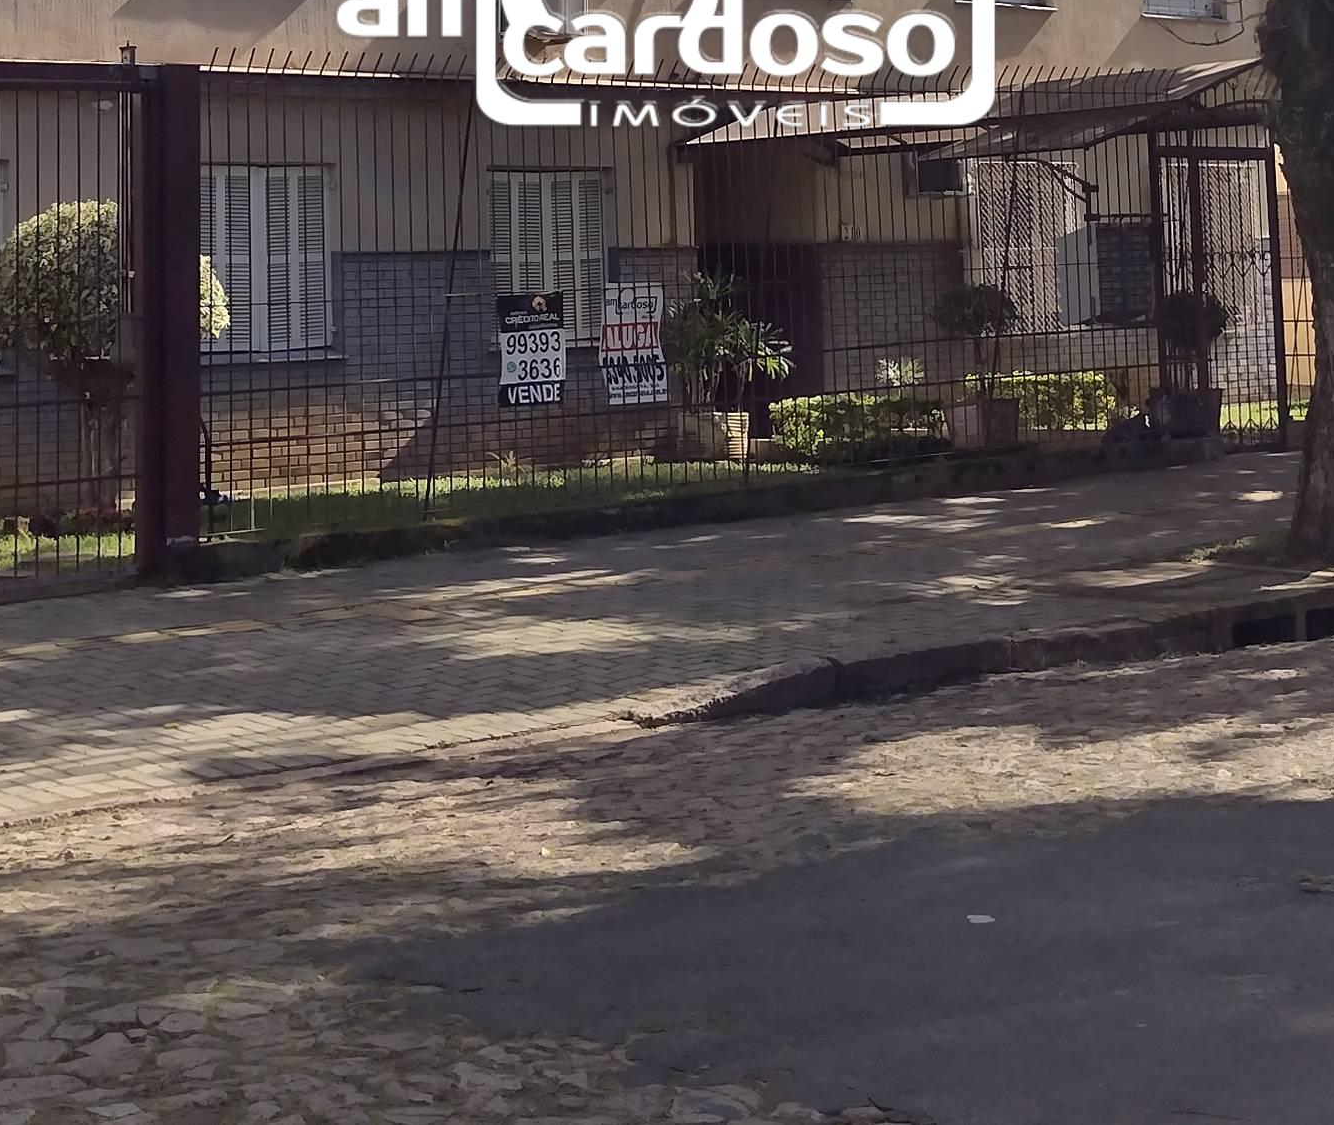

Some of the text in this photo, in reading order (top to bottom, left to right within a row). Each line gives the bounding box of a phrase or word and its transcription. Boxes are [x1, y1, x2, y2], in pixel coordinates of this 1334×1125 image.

[506, 331, 561, 355] 99393
[602, 324, 657, 350] ALUGA
[518, 357, 560, 380] 3636
[508, 383, 561, 404] VENDE
